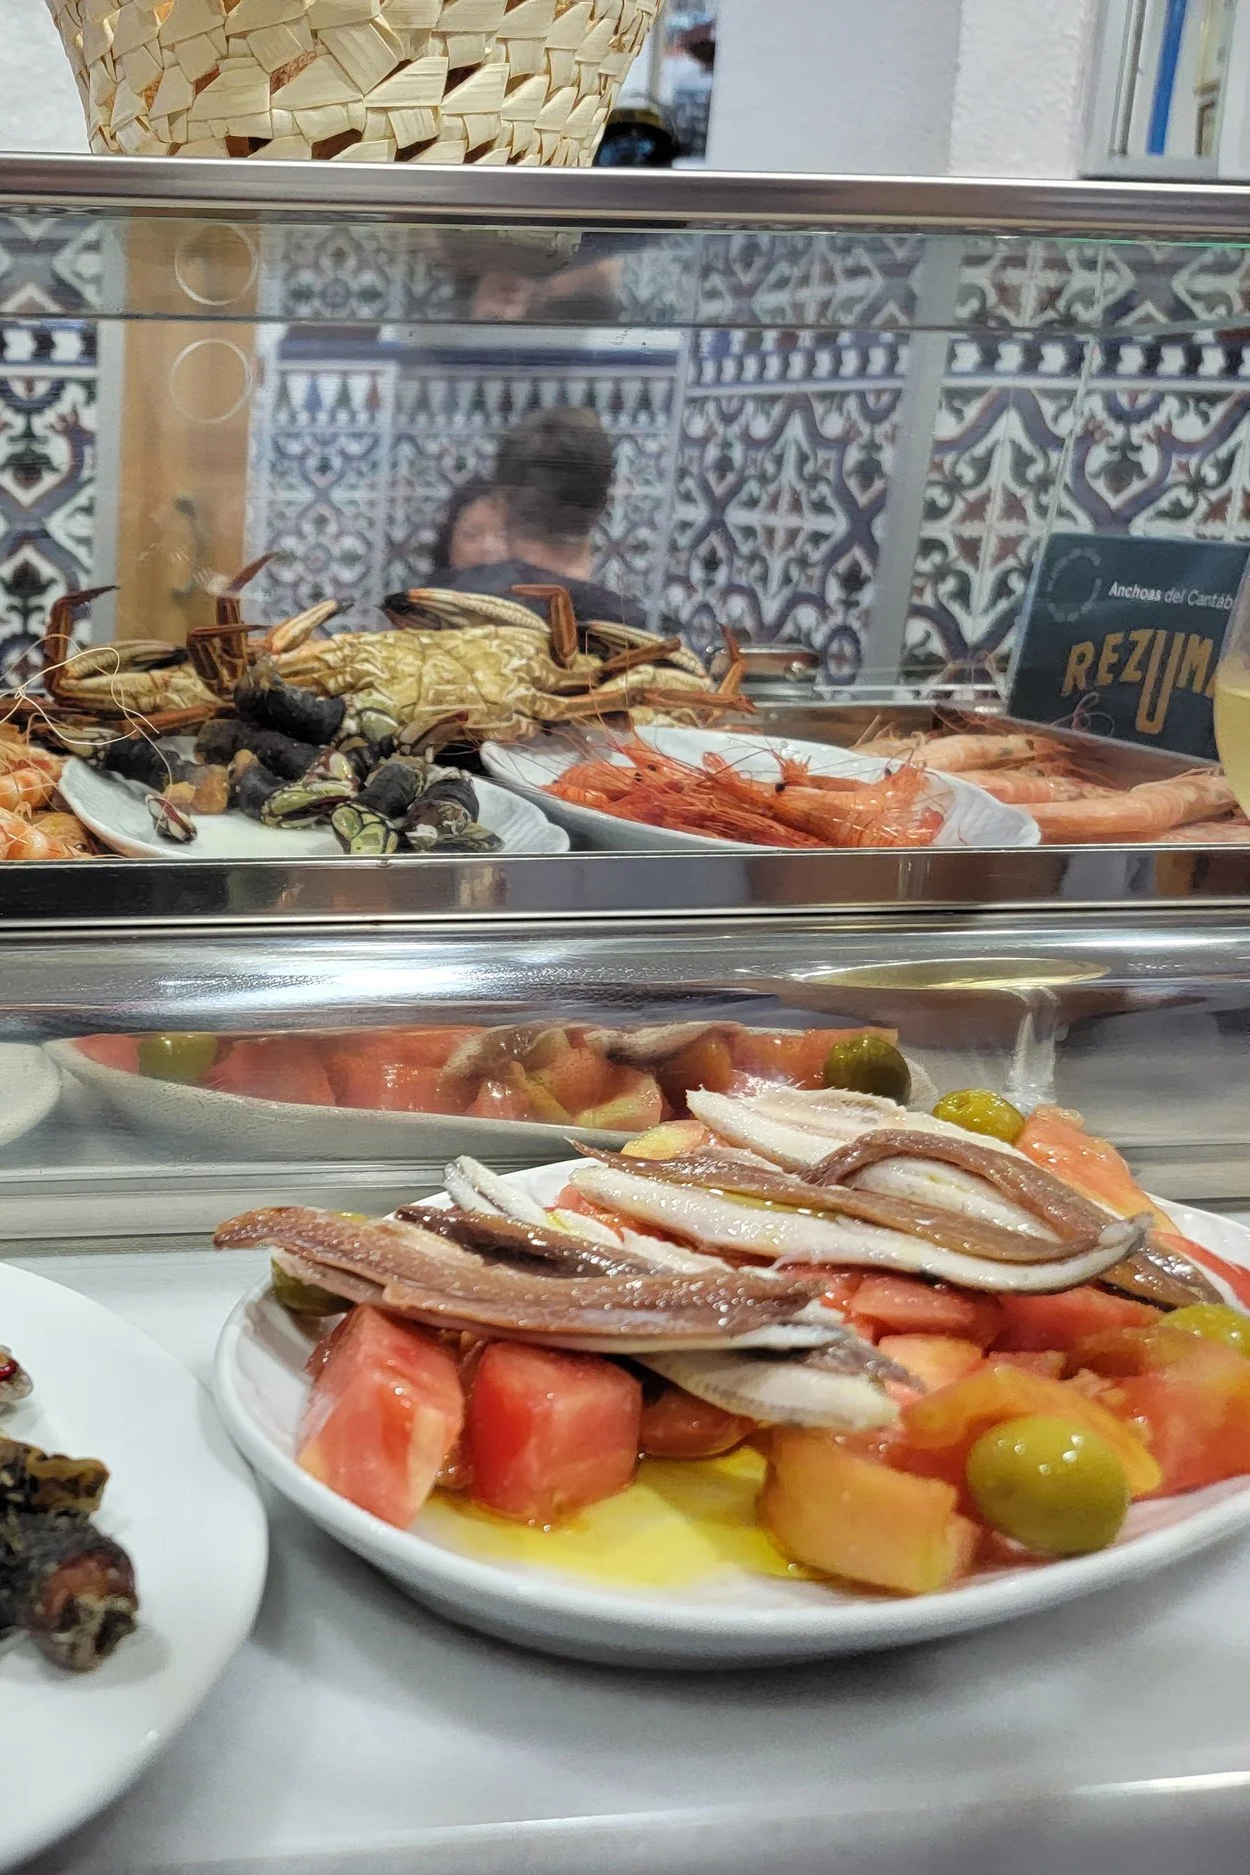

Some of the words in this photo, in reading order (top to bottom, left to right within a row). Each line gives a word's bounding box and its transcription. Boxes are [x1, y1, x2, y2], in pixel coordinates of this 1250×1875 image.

[1108, 580, 1162, 601] Anchoas
[1164, 588, 1184, 604] del
[1187, 588, 1235, 611] Cantáb
[1059, 628, 1216, 735] REZUM
